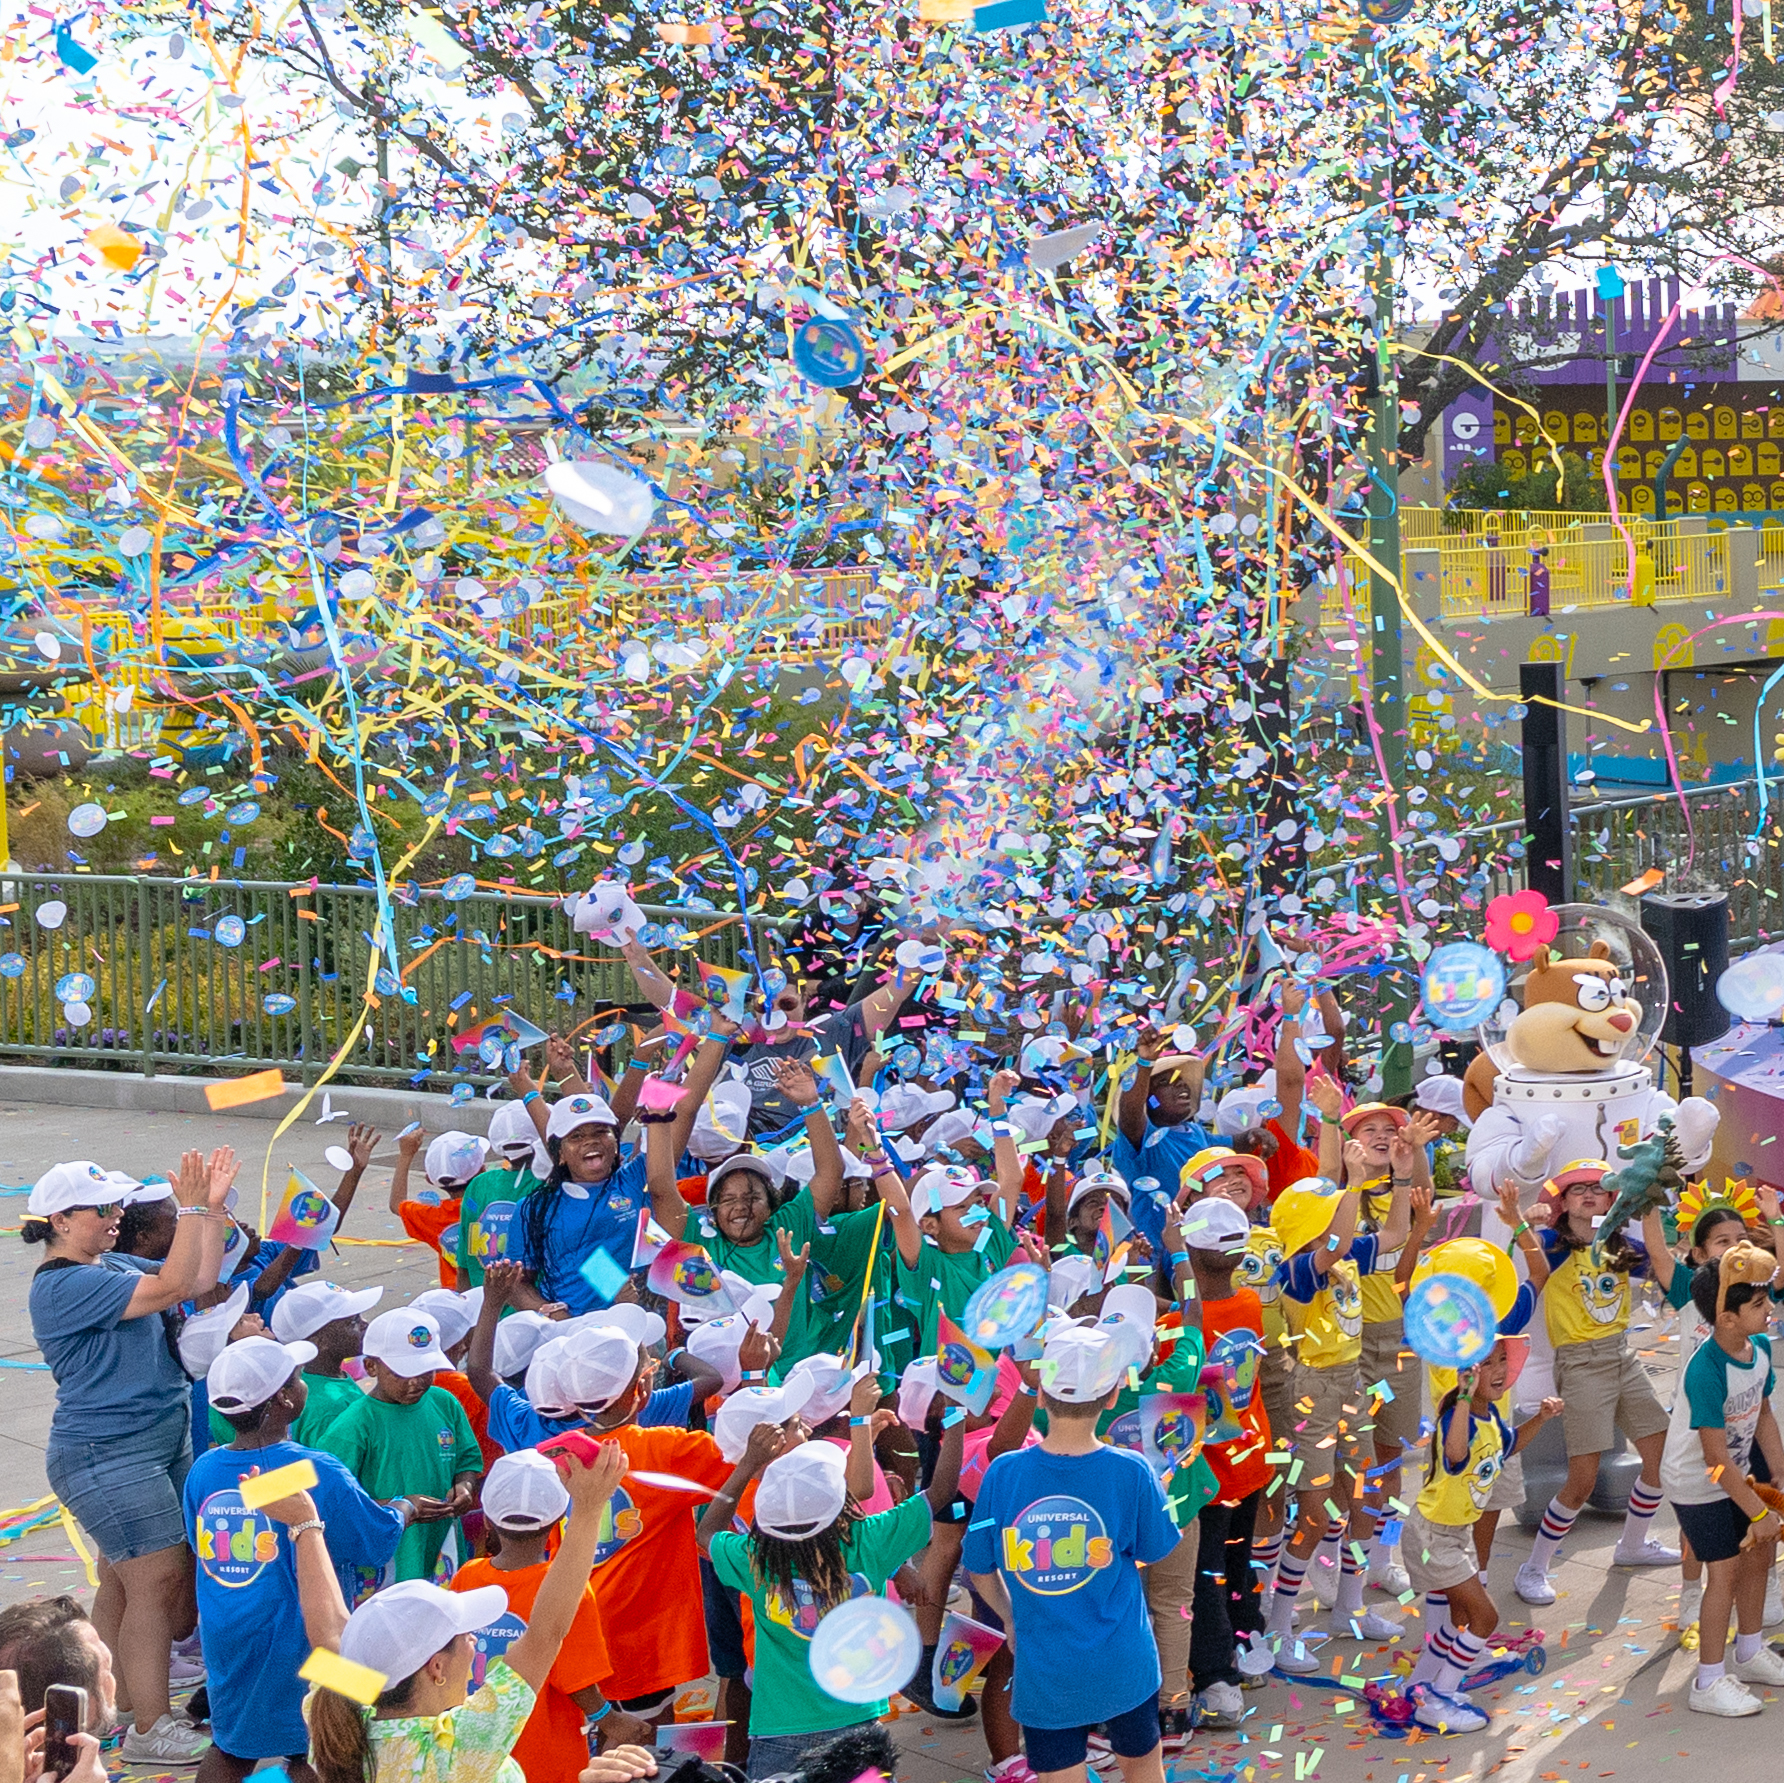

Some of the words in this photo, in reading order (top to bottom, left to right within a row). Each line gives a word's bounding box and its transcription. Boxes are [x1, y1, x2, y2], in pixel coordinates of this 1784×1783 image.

[1428, 972, 1494, 1004] kids
[207, 1505, 258, 1516] UNIVERSAL
[1027, 1512, 1091, 1524] UNIVERSAL
[196, 1515, 279, 1563] kids
[1002, 1523, 1113, 1573] kids
[1037, 1572, 1078, 1583] RESORT
